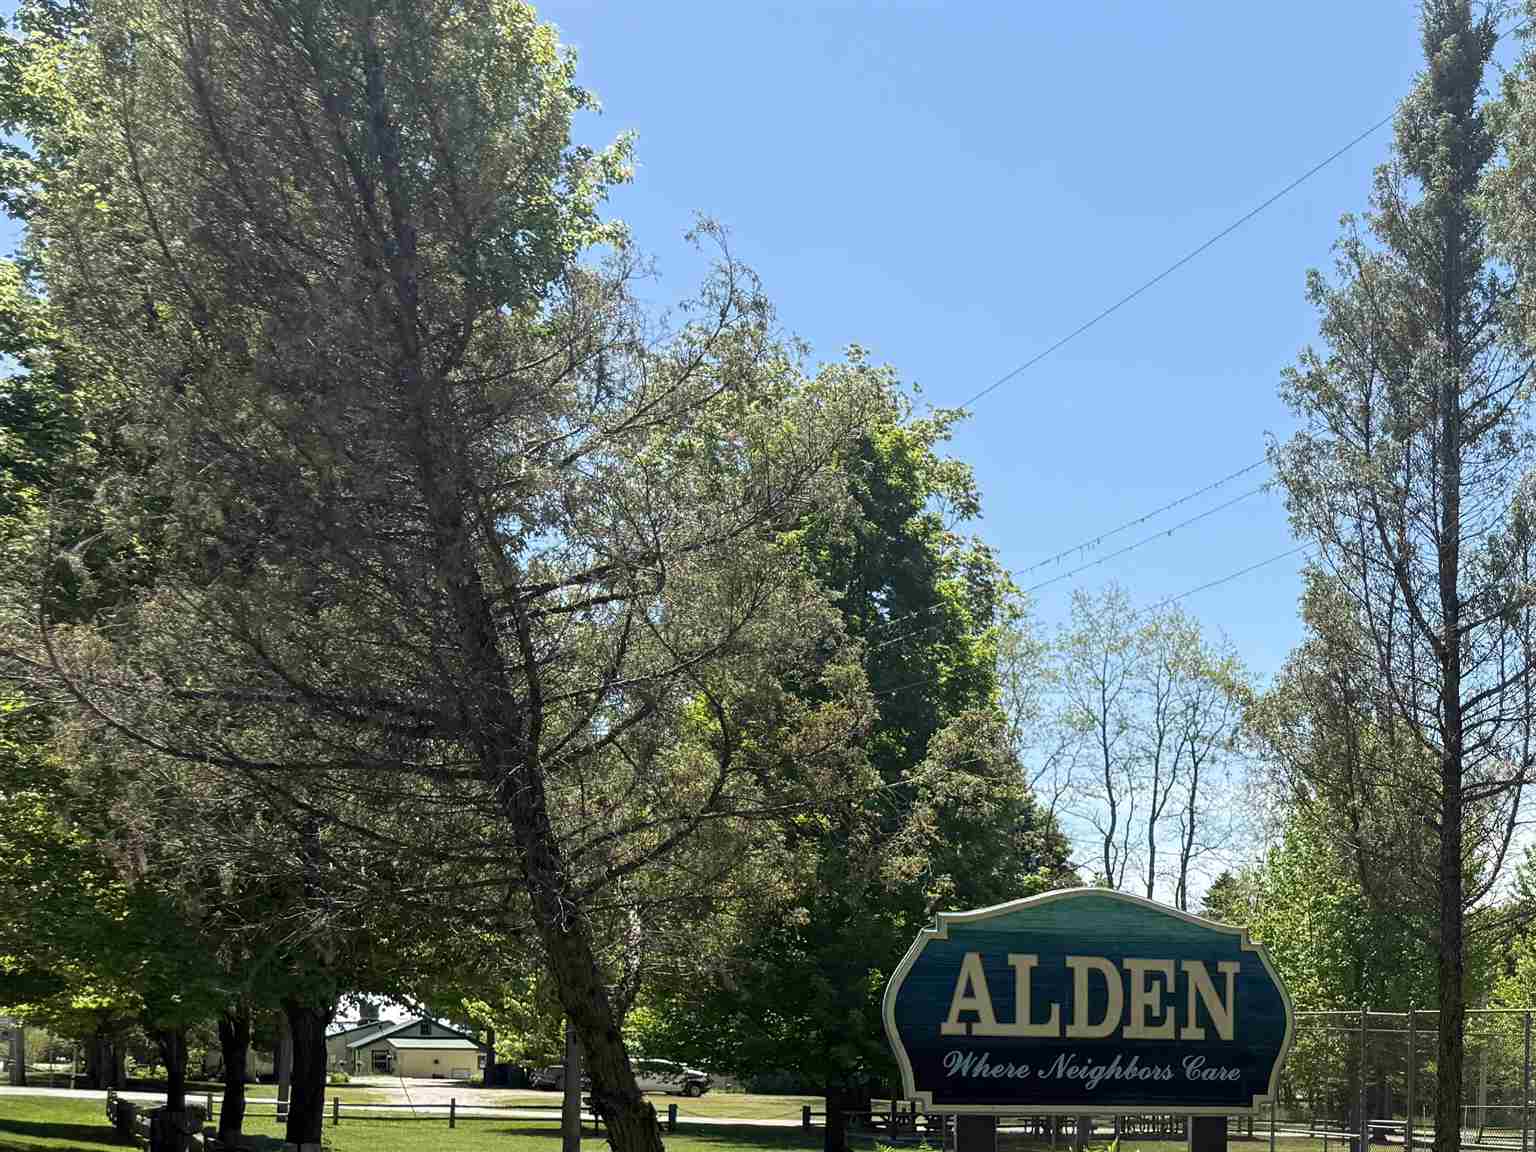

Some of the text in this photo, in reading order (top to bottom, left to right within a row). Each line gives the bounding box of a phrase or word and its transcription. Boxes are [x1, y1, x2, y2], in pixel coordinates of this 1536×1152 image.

[941, 951, 1241, 1041] ALDEN
[943, 1050, 1241, 1090] Where Neighbors Care
